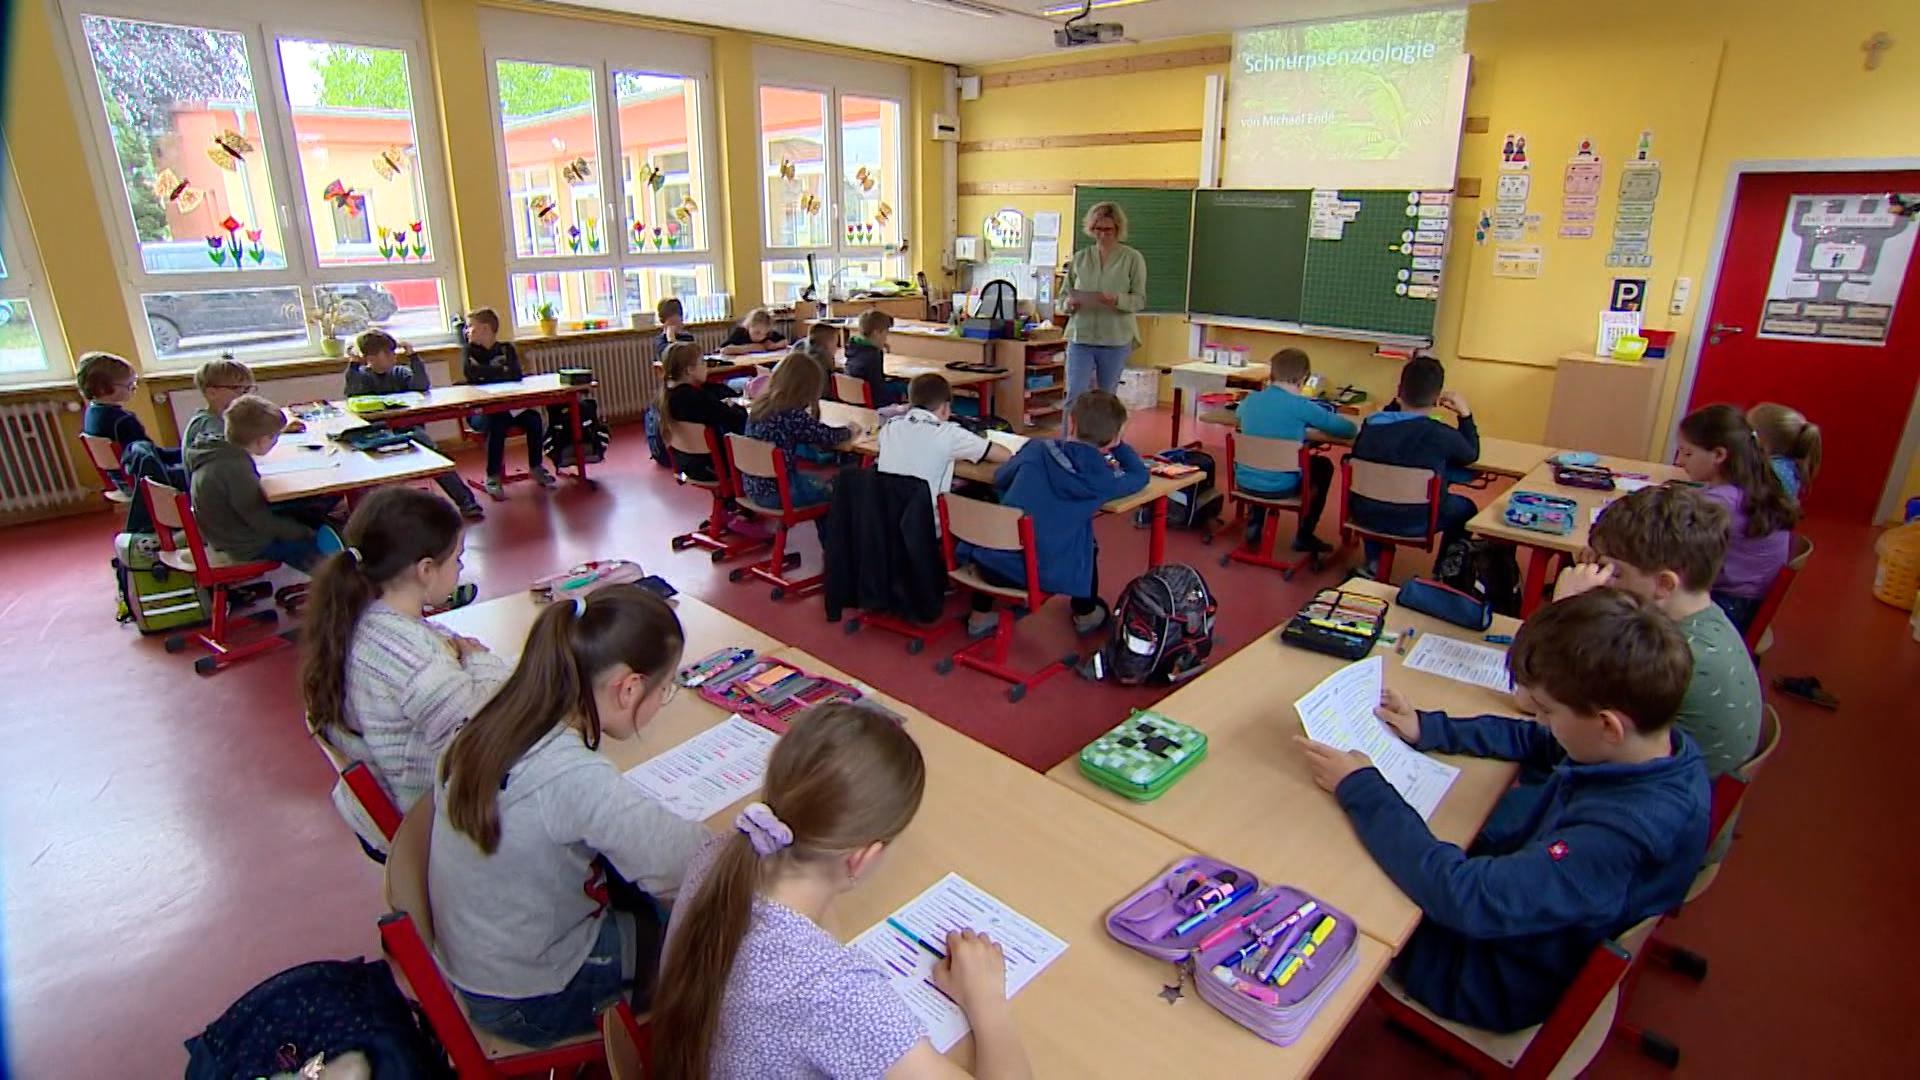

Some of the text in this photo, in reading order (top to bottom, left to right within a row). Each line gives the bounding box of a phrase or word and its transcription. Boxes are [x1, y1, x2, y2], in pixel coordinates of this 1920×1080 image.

[1244, 41, 1436, 74] Schnurpsenzoologie
[1240, 111, 1335, 129] von Michael Ende
[1615, 282, 1639, 309] P
